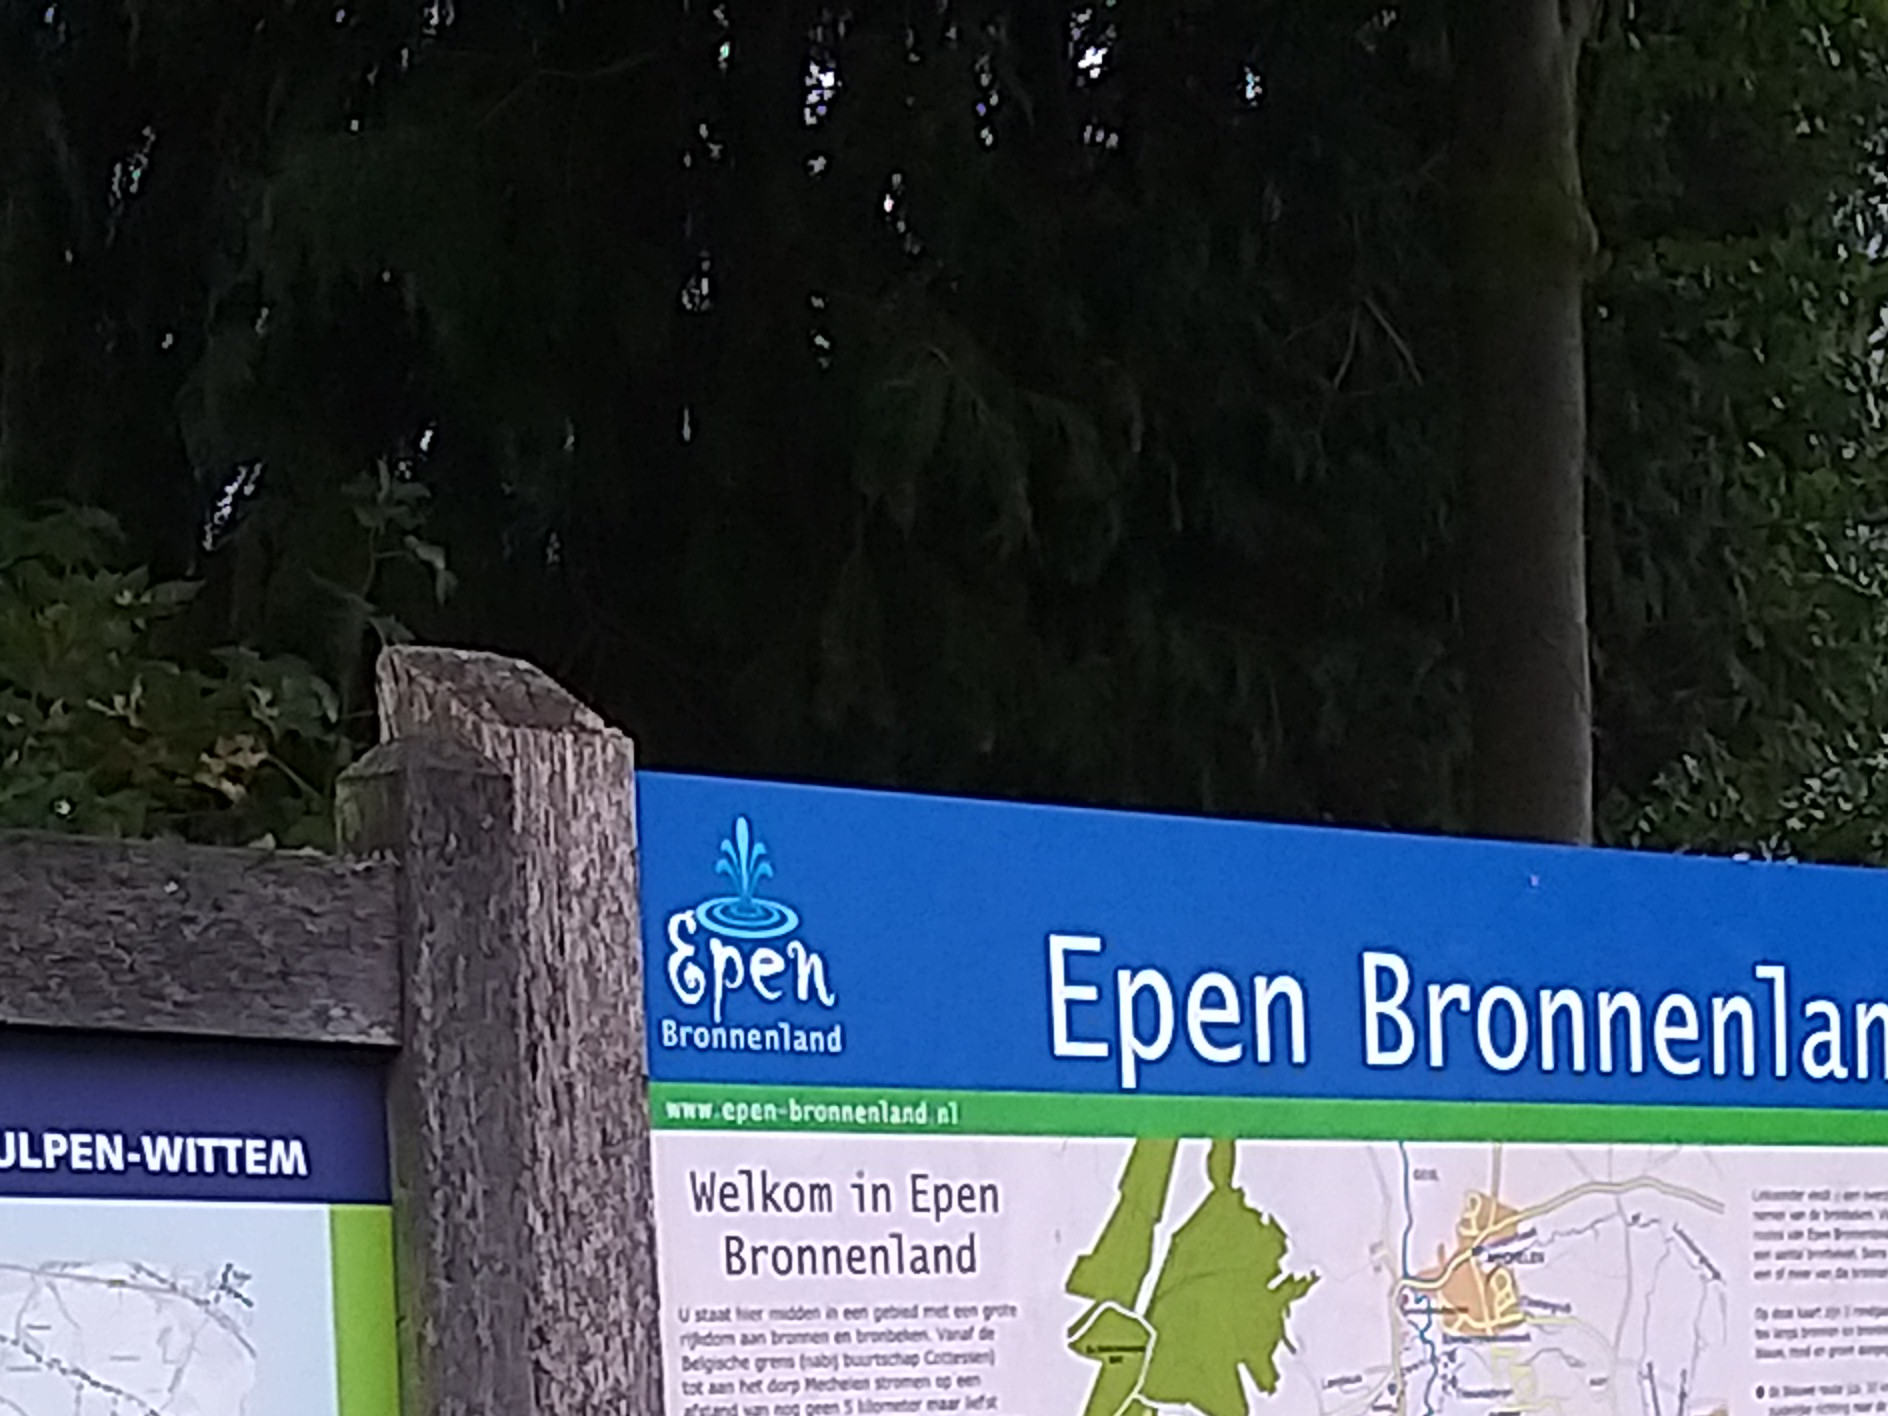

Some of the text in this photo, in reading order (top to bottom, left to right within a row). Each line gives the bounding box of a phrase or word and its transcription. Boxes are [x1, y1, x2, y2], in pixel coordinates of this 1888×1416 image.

[667, 909, 835, 1023] Epen
[1048, 933, 1307, 1089] Epen
[661, 1019, 843, 1052] Bronnenland
[664, 1098, 960, 1125] www.epen-bronnenland.nl
[689, 1170, 1000, 1222] Welkom in Epen
[724, 1232, 977, 1275] Bronnenland
